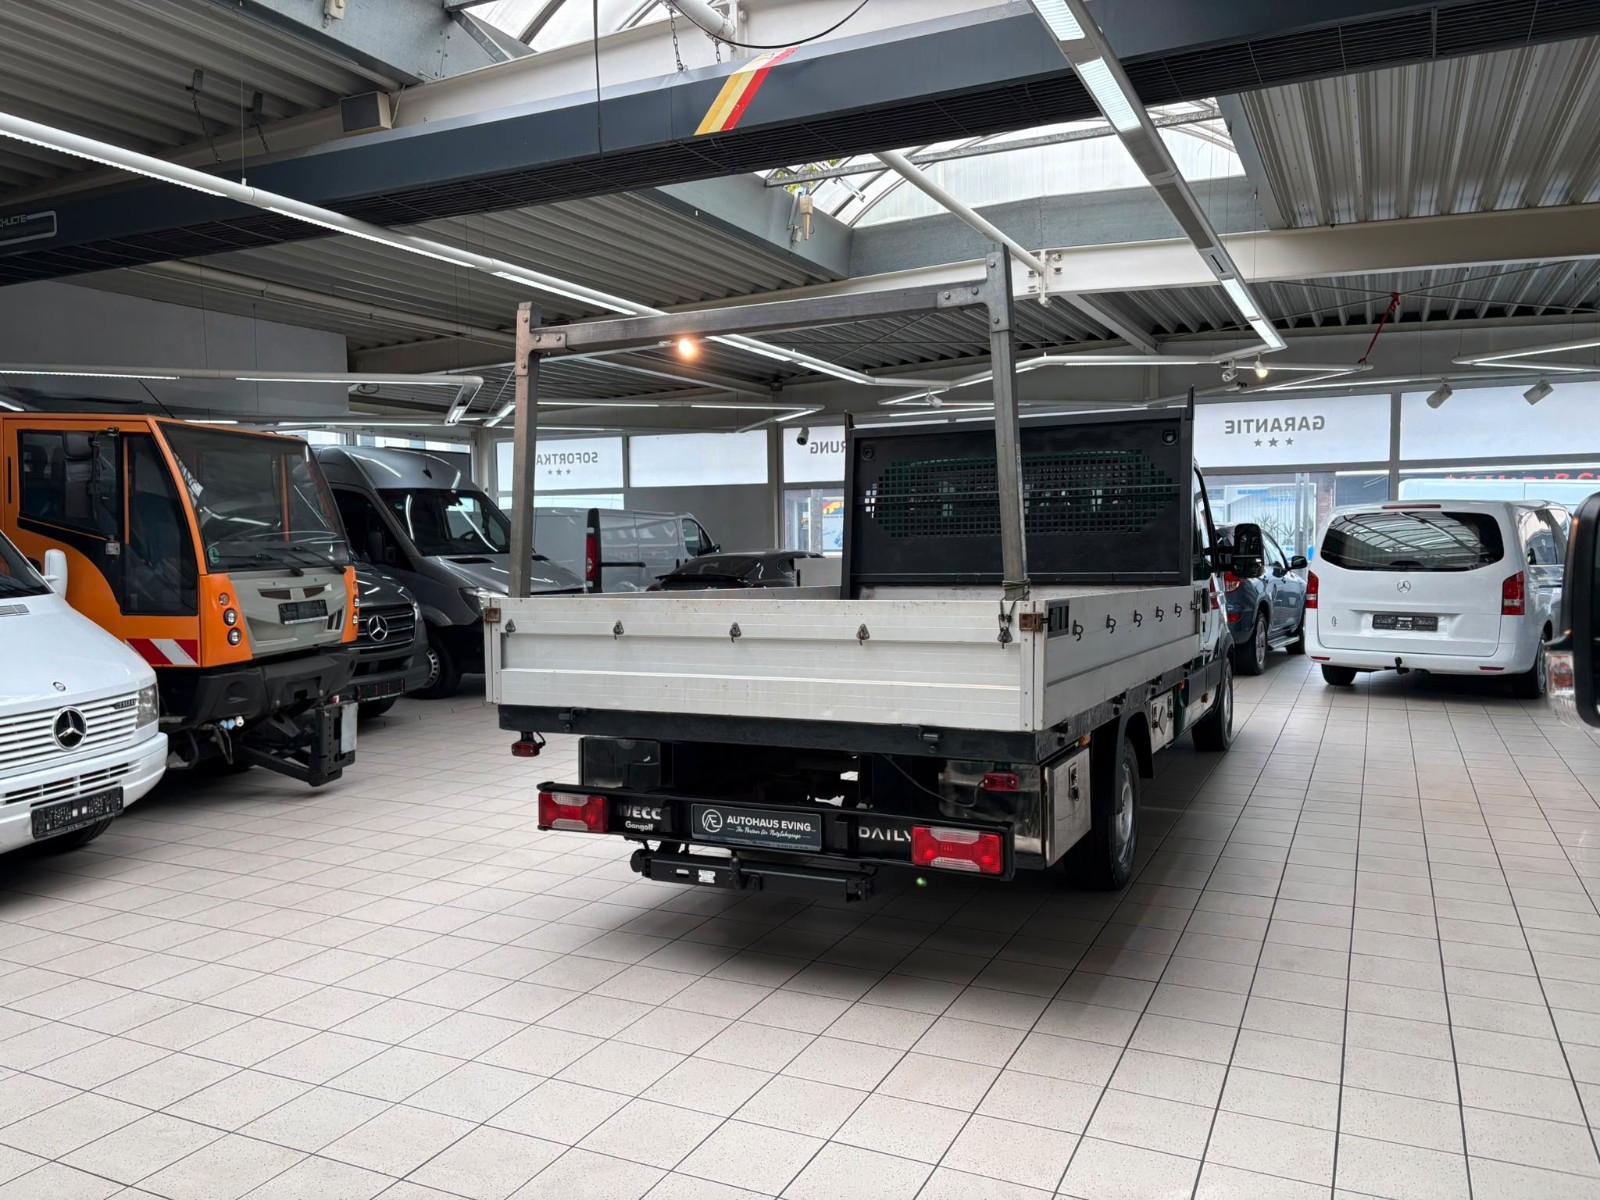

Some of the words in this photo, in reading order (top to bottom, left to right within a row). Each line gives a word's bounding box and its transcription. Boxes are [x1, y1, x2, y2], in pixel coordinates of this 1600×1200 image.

[625, 820, 654, 831] Gangolf
[727, 815, 779, 829] AUTOHAUS
[781, 820, 811, 832] EVING
[858, 826, 912, 842] DAILY
